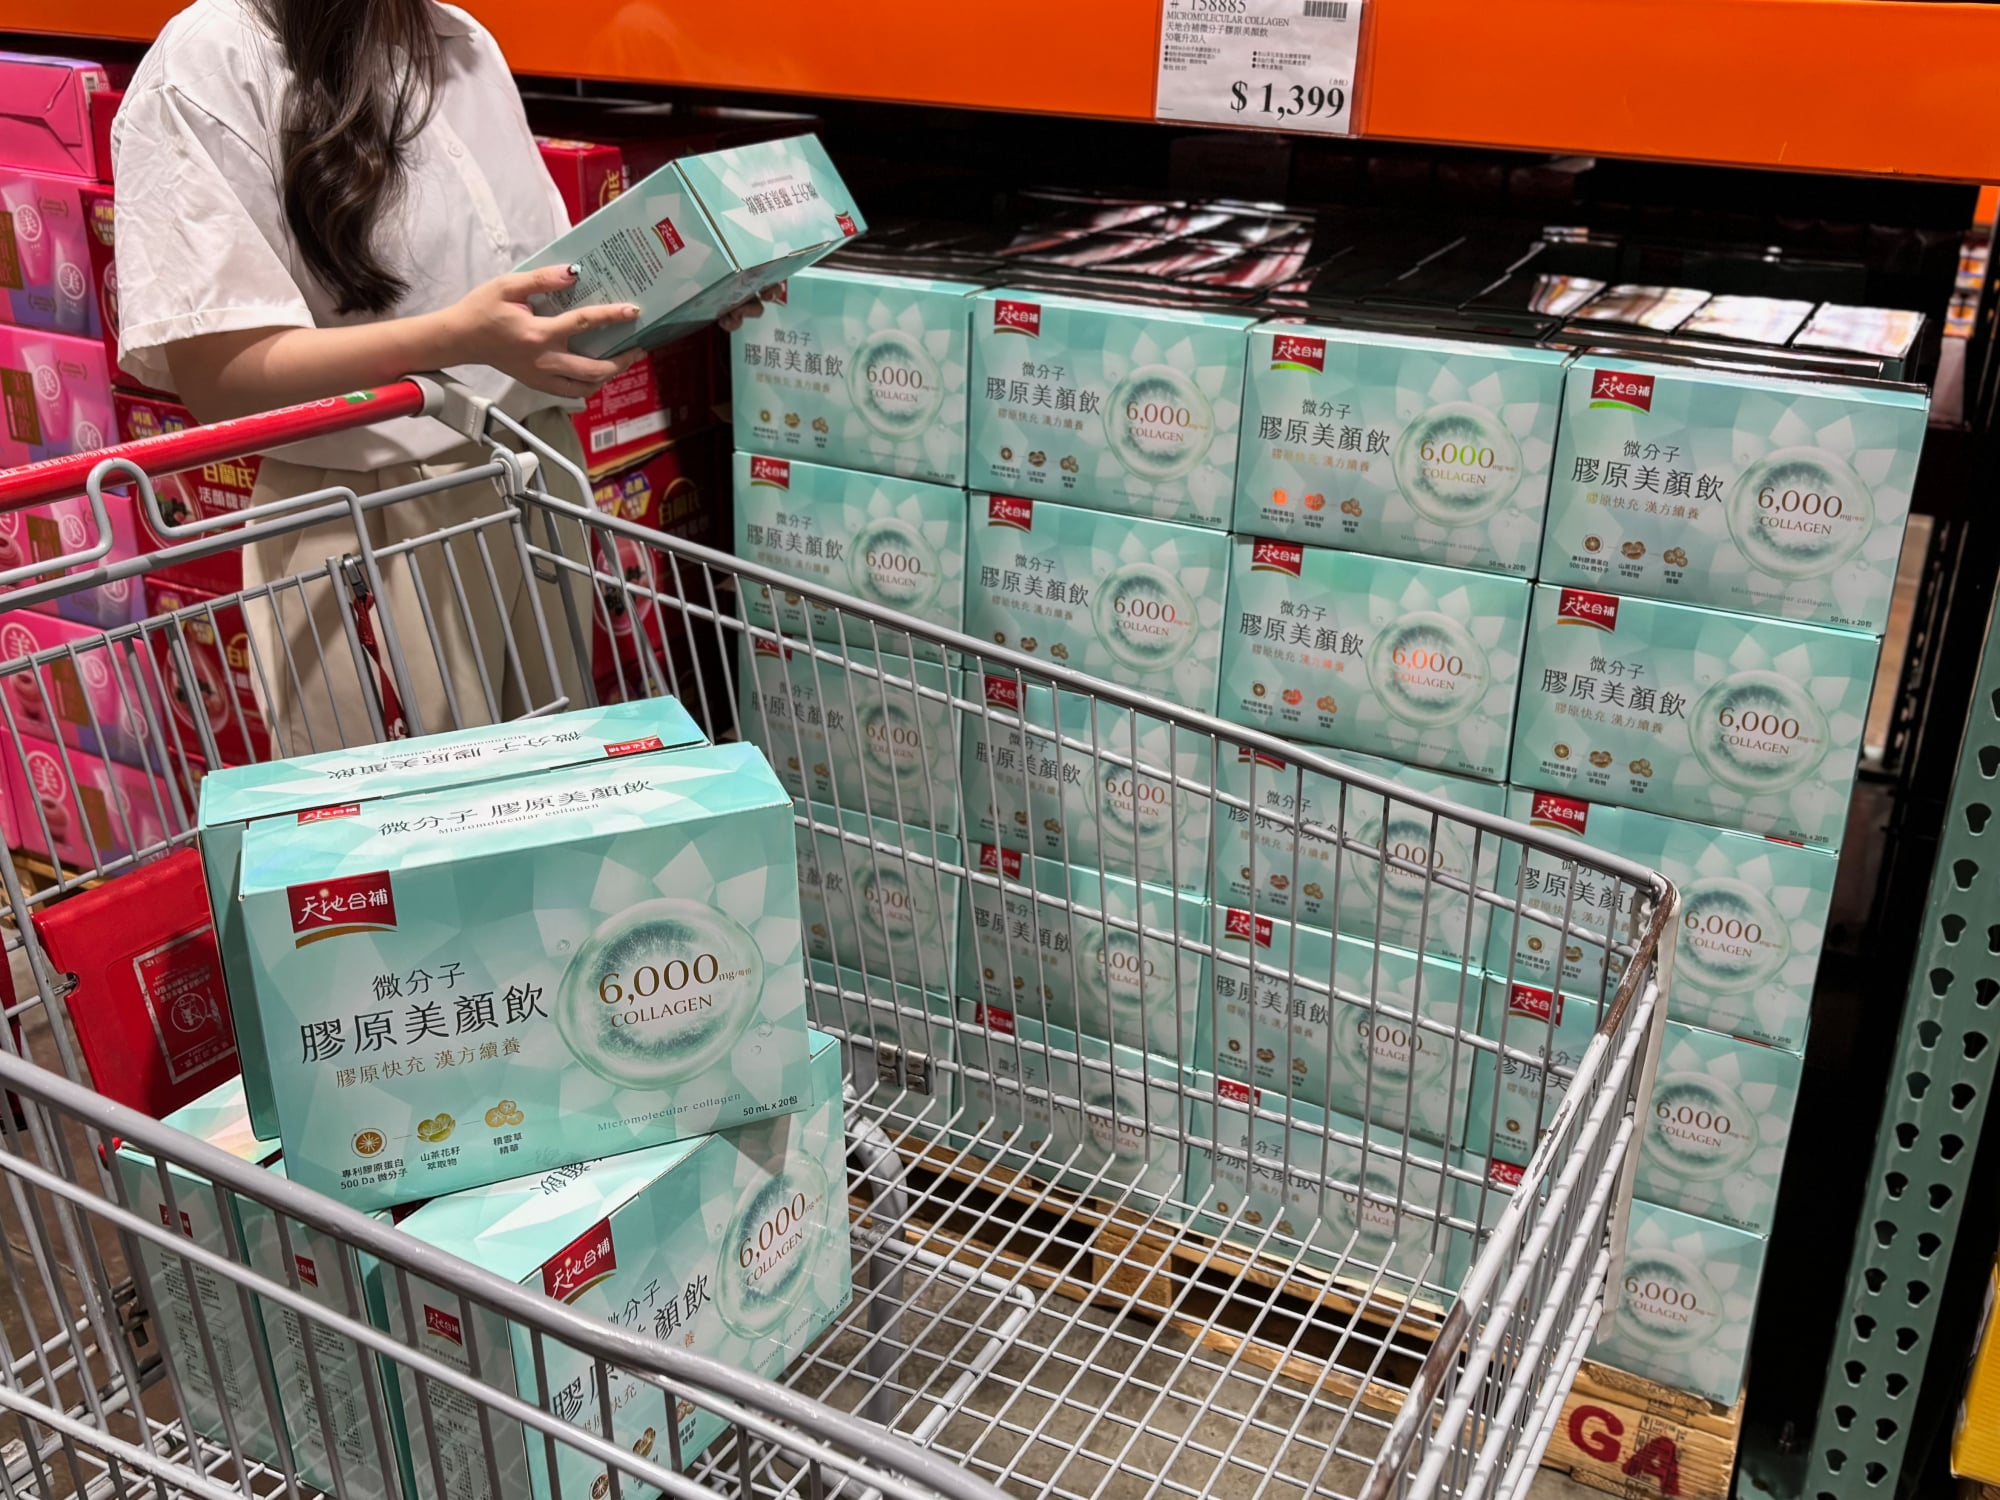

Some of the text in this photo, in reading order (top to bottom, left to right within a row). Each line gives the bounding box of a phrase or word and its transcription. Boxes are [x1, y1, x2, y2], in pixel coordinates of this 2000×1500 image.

[1166, 11, 1289, 27] MICROMOLECULAR COLLAGEN
[1191, 0, 1246, 13] 158885
[1231, 80, 1345, 121] $ 1,399
[744, 343, 844, 379] 膠原美顏飲
[1274, 341, 1323, 360] 天地合補
[867, 363, 923, 390] 6,000
[1022, 361, 1065, 382] 微分子
[985, 377, 1100, 416] 膠原美顏飲
[1594, 377, 1650, 398] 天地合補
[1126, 401, 1190, 428] 6,000
[1301, 398, 1352, 421] 微分子
[1128, 427, 1185, 443] COLLAGEN
[1258, 414, 1391, 458] 膠原美顏飲
[1420, 439, 1495, 470] 6,000
[1623, 439, 1681, 464] 微分子
[1422, 466, 1487, 485] COLLAGEN
[1571, 456, 1725, 503] 膠原美顏飲
[1758, 485, 1843, 519] 6,000
[1759, 515, 1832, 536] COLLAGEN
[747, 523, 844, 562] 膠原美顏飲
[1255, 544, 1301, 563] 天地合補
[866, 550, 921, 575] 6,000
[1015, 553, 1056, 574] 微分子
[980, 565, 1088, 608] 膠原美顏飲
[1113, 596, 1176, 623] 6,000
[1280, 599, 1327, 622] 微分子
[1561, 598, 1616, 618] 天地合補
[1116, 619, 1170, 636] COLLAGEN
[1239, 612, 1365, 659] 膠原美顏飲
[1392, 646, 1464, 676] 6,000
[1589, 655, 1645, 680] 微分子
[1393, 671, 1456, 690] COLLAGEN
[1541, 669, 1686, 720] 膠原美顏飲
[1718, 707, 1800, 740] 6,000
[1719, 734, 1790, 755] COLLAGEN
[1105, 777, 1165, 804] 6,000
[378, 780, 655, 836] 微分子 膠原美顏飲
[438, 802, 602, 836] Micromolecular collagen
[1534, 802, 1586, 822] 天地合補
[297, 886, 389, 925] 天地合補
[1684, 910, 1762, 944] 6,000
[1685, 934, 1753, 958] COLLAGEN
[372, 961, 466, 1000] 微分子
[599, 953, 719, 1006] 6,000
[300, 981, 548, 1064] 膠原美顏飲
[610, 994, 713, 1028] COLLAGEN
[335, 1036, 521, 1089] 膠原快充 漢方續養
[597, 1091, 742, 1133] Micromolecular collagen
[743, 1107, 755, 1117] 50
[755, 1104, 771, 1114] mL
[778, 1096, 798, 1107] 20包
[1656, 1101, 1731, 1134] 6,000
[493, 1131, 523, 1147] 積雪草
[499, 1143, 520, 1155] 精華
[1658, 1123, 1722, 1148] COLLAGEN
[420, 1145, 461, 1162] 山茶花籽
[427, 1157, 458, 1171] 萃取物
[340, 1168, 409, 1190] 500 Da 微分子
[341, 1158, 405, 1179] 專利膠原蛋白
[740, 1191, 806, 1269] 6,000
[552, 1237, 612, 1299] 天地合補
[746, 1227, 804, 1287] COLLAGEN
[1625, 1277, 1697, 1312] 6,000
[1628, 1298, 1689, 1323] COLLAGEN
